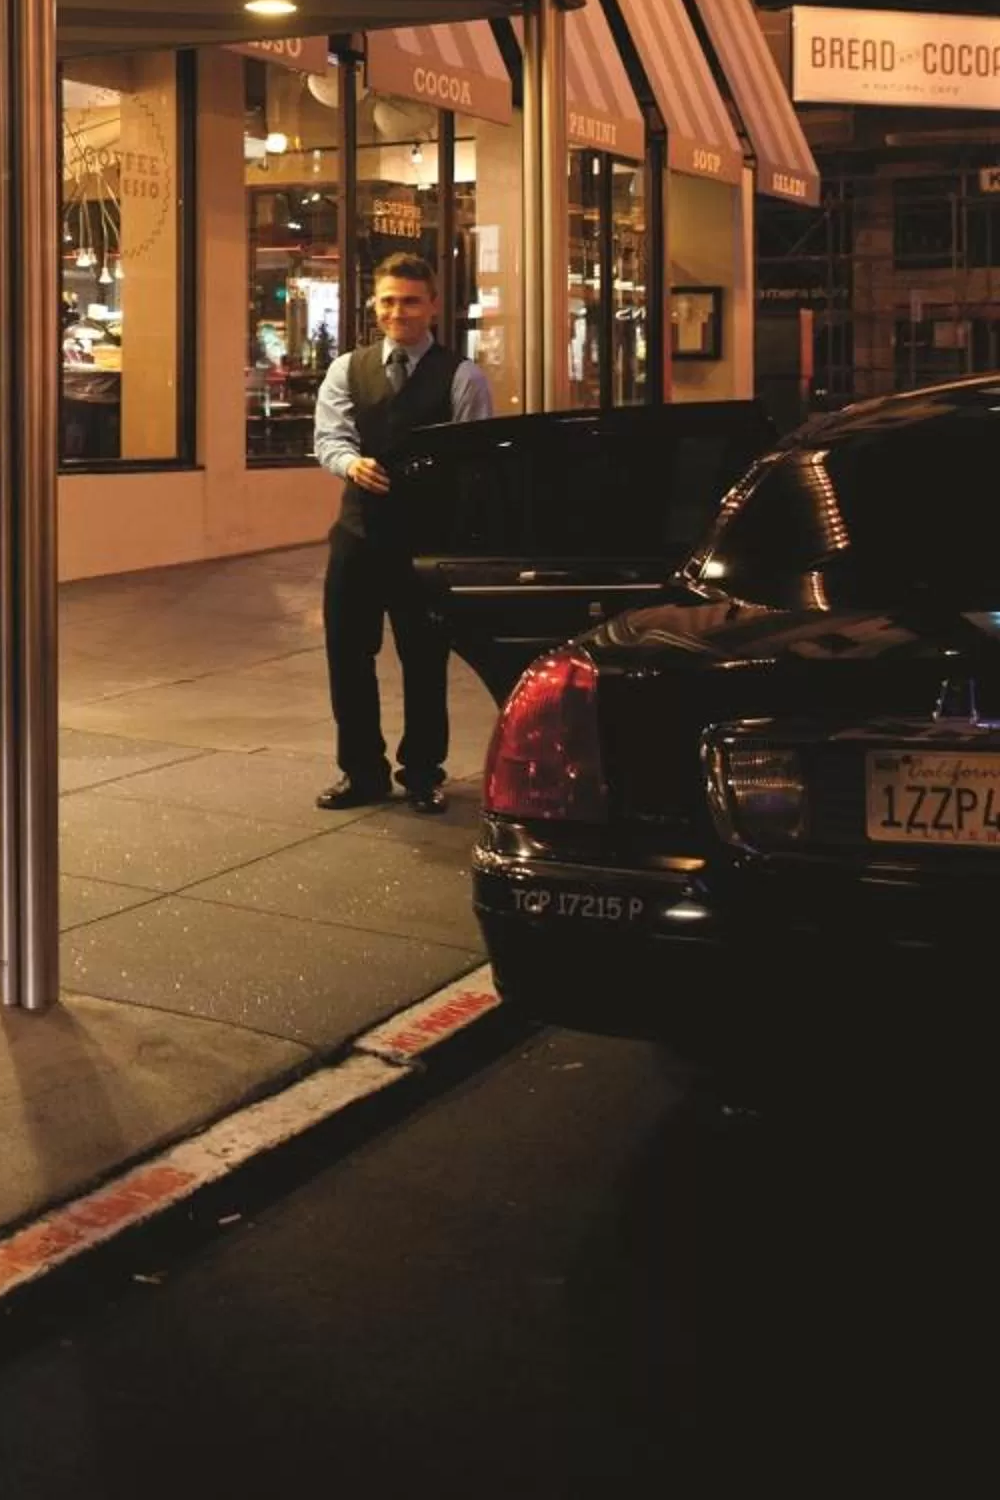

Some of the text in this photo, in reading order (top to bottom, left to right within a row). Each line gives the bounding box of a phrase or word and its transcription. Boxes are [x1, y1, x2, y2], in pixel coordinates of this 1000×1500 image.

[811, 36, 896, 72] BREAD
[412, 67, 473, 106] COCOA
[569, 111, 617, 146] PANINI
[693, 149, 721, 173] SOUP
[880, 784, 1000, 830] 1ZZP4
[511, 888, 644, 920] TCP 17215 P
